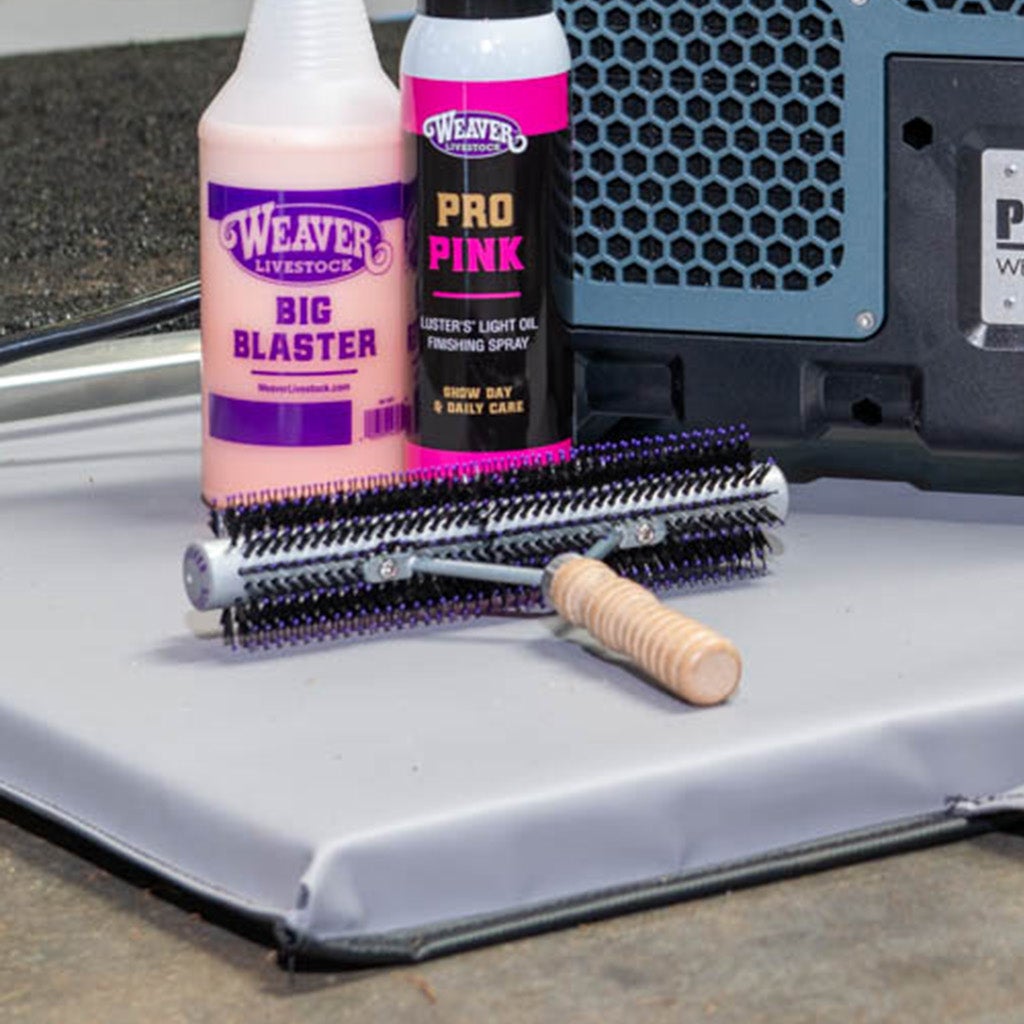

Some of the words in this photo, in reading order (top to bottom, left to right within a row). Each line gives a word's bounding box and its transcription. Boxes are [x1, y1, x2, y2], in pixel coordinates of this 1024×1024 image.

[422, 109, 528, 154] WEAVER
[444, 142, 500, 153] LIVESTOCK
[436, 192, 514, 228] PRO
[220, 201, 393, 275] WEAVER
[428, 235, 525, 273] PINK
[254, 258, 353, 274] LIVESTOCK
[275, 295, 332, 325] BIG
[479, 318, 516, 333] LIGHT
[518, 317, 538, 331] OIL
[233, 328, 377, 362] BLASTER
[427, 336, 485, 352] FINISHING
[488, 337, 530, 352] SPRAY
[443, 386, 480, 400] SHOW
[485, 386, 513, 400] DAY
[446, 402, 484, 414] DAILY
[488, 400, 524, 415] CARE
